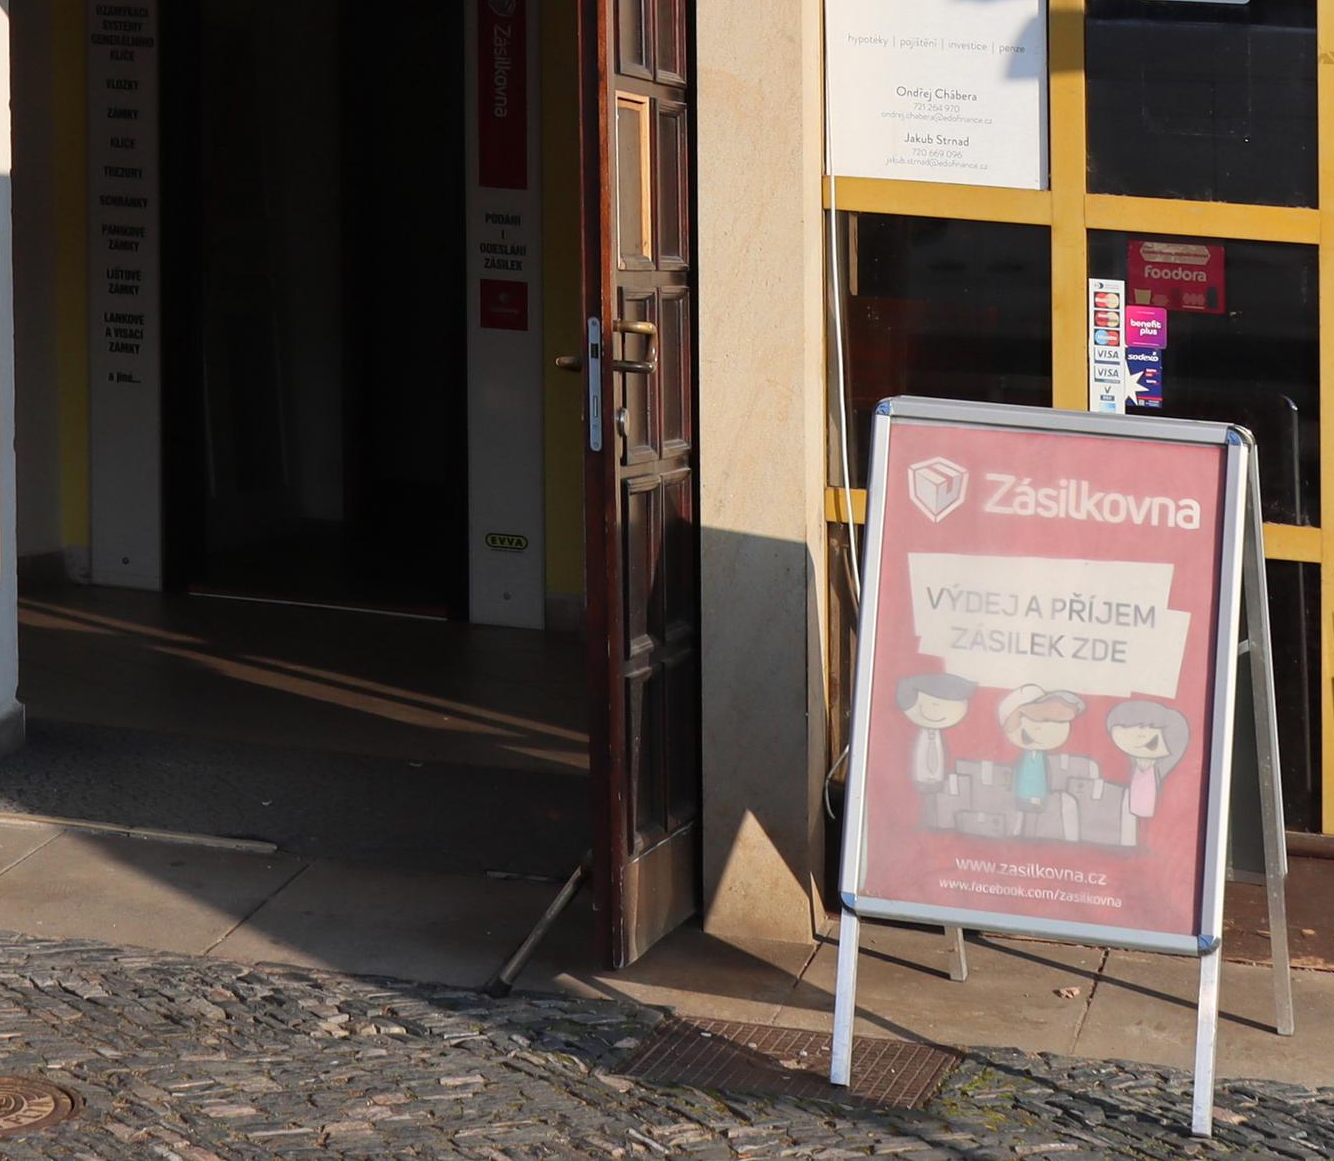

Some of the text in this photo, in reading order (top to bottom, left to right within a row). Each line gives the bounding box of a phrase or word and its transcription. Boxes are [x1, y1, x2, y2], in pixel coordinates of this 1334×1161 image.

[948, 40, 987, 52] investice
[492, 23, 512, 119] Zásilkovna
[896, 85, 978, 102] Ondřej Chábera
[904, 133, 970, 147] Jakub Strnad
[1145, 265, 1208, 282] foodora
[1130, 319, 1162, 330] benefit
[1139, 327, 1158, 337] plus
[1097, 351, 1119, 360] VISA
[1128, 351, 1159, 363] sodexo
[1097, 369, 1119, 378] VISA
[983, 471, 1201, 531] Zásilkovna
[490, 536, 524, 547] EVVA
[926, 583, 1156, 629] VÝDEJ A PŘÍJEM
[950, 623, 1129, 664] ZÁSILEK ZDE
[955, 857, 1108, 886] www.zasilkovna.cz
[939, 878, 1123, 908] www.facebook.com/zasilkovna
